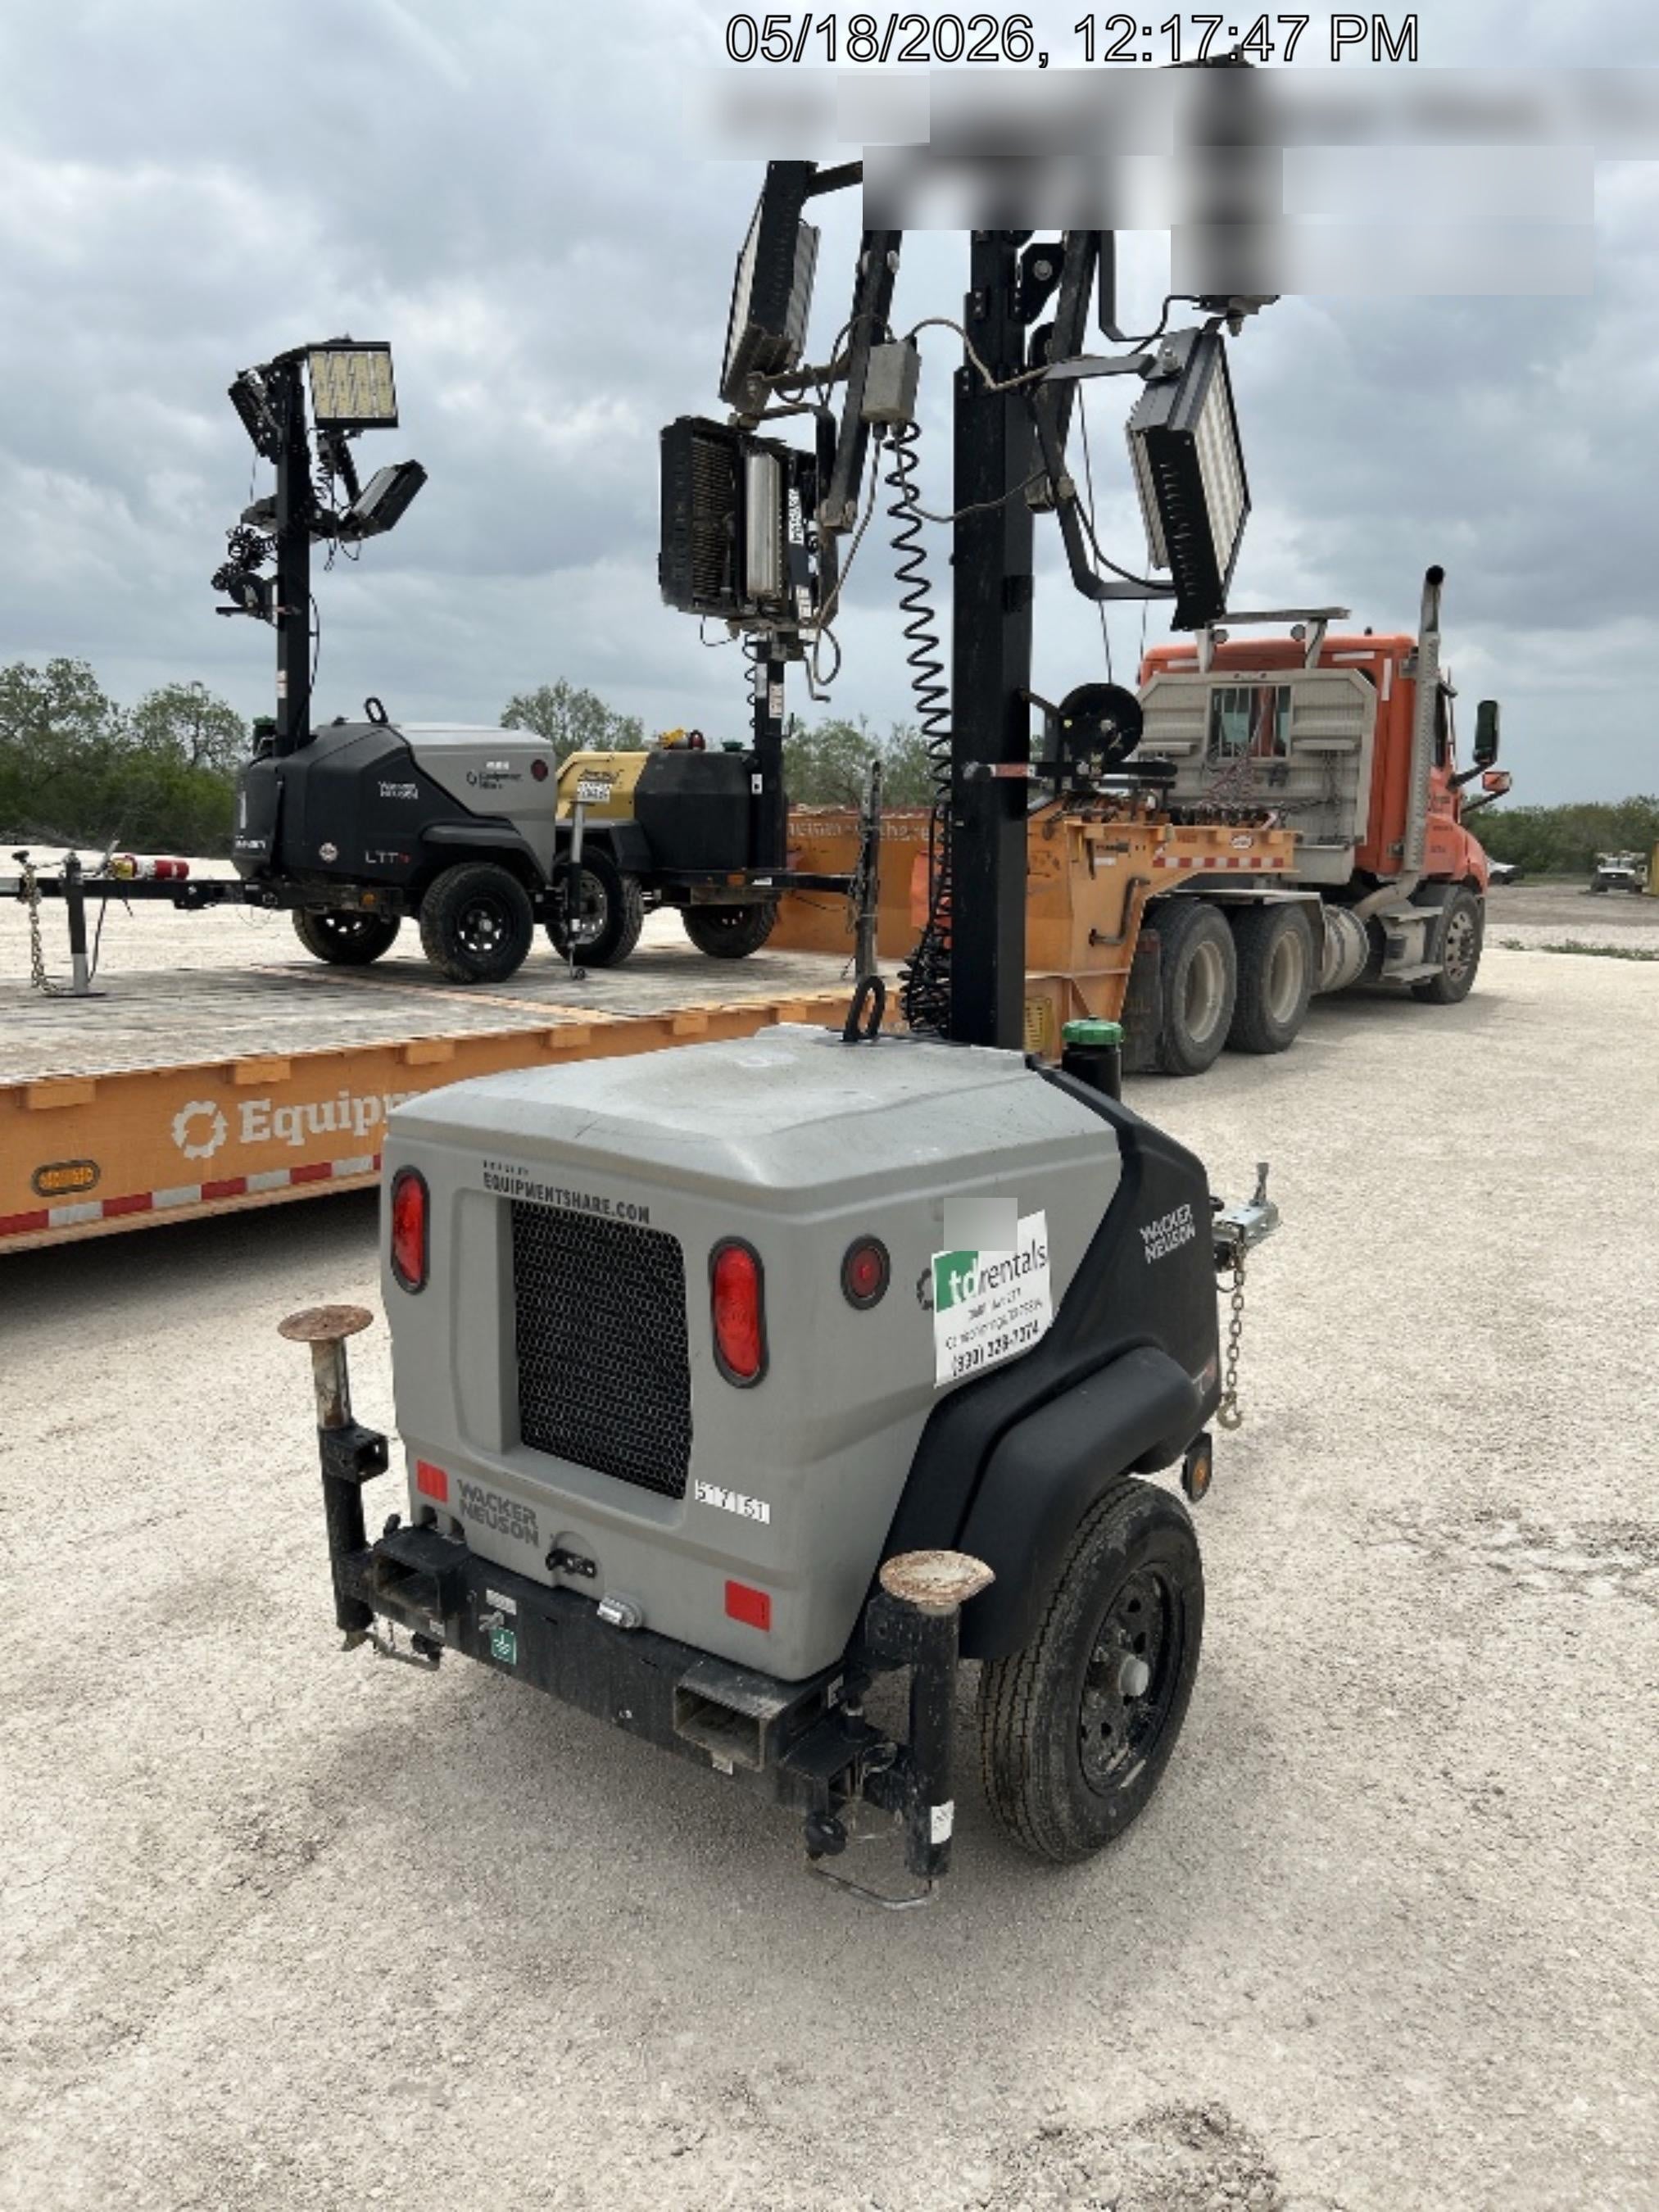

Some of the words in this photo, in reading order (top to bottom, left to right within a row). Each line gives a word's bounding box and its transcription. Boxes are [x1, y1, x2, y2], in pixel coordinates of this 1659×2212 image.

[483, 1172, 650, 1224] EQUIPMENTSHARE.COM
[1139, 1203, 1194, 1240] WACKER
[1145, 1224, 1197, 1264] NEUSON
[458, 1480, 537, 1526] WACKER
[460, 1499, 539, 1546] NEUSON
